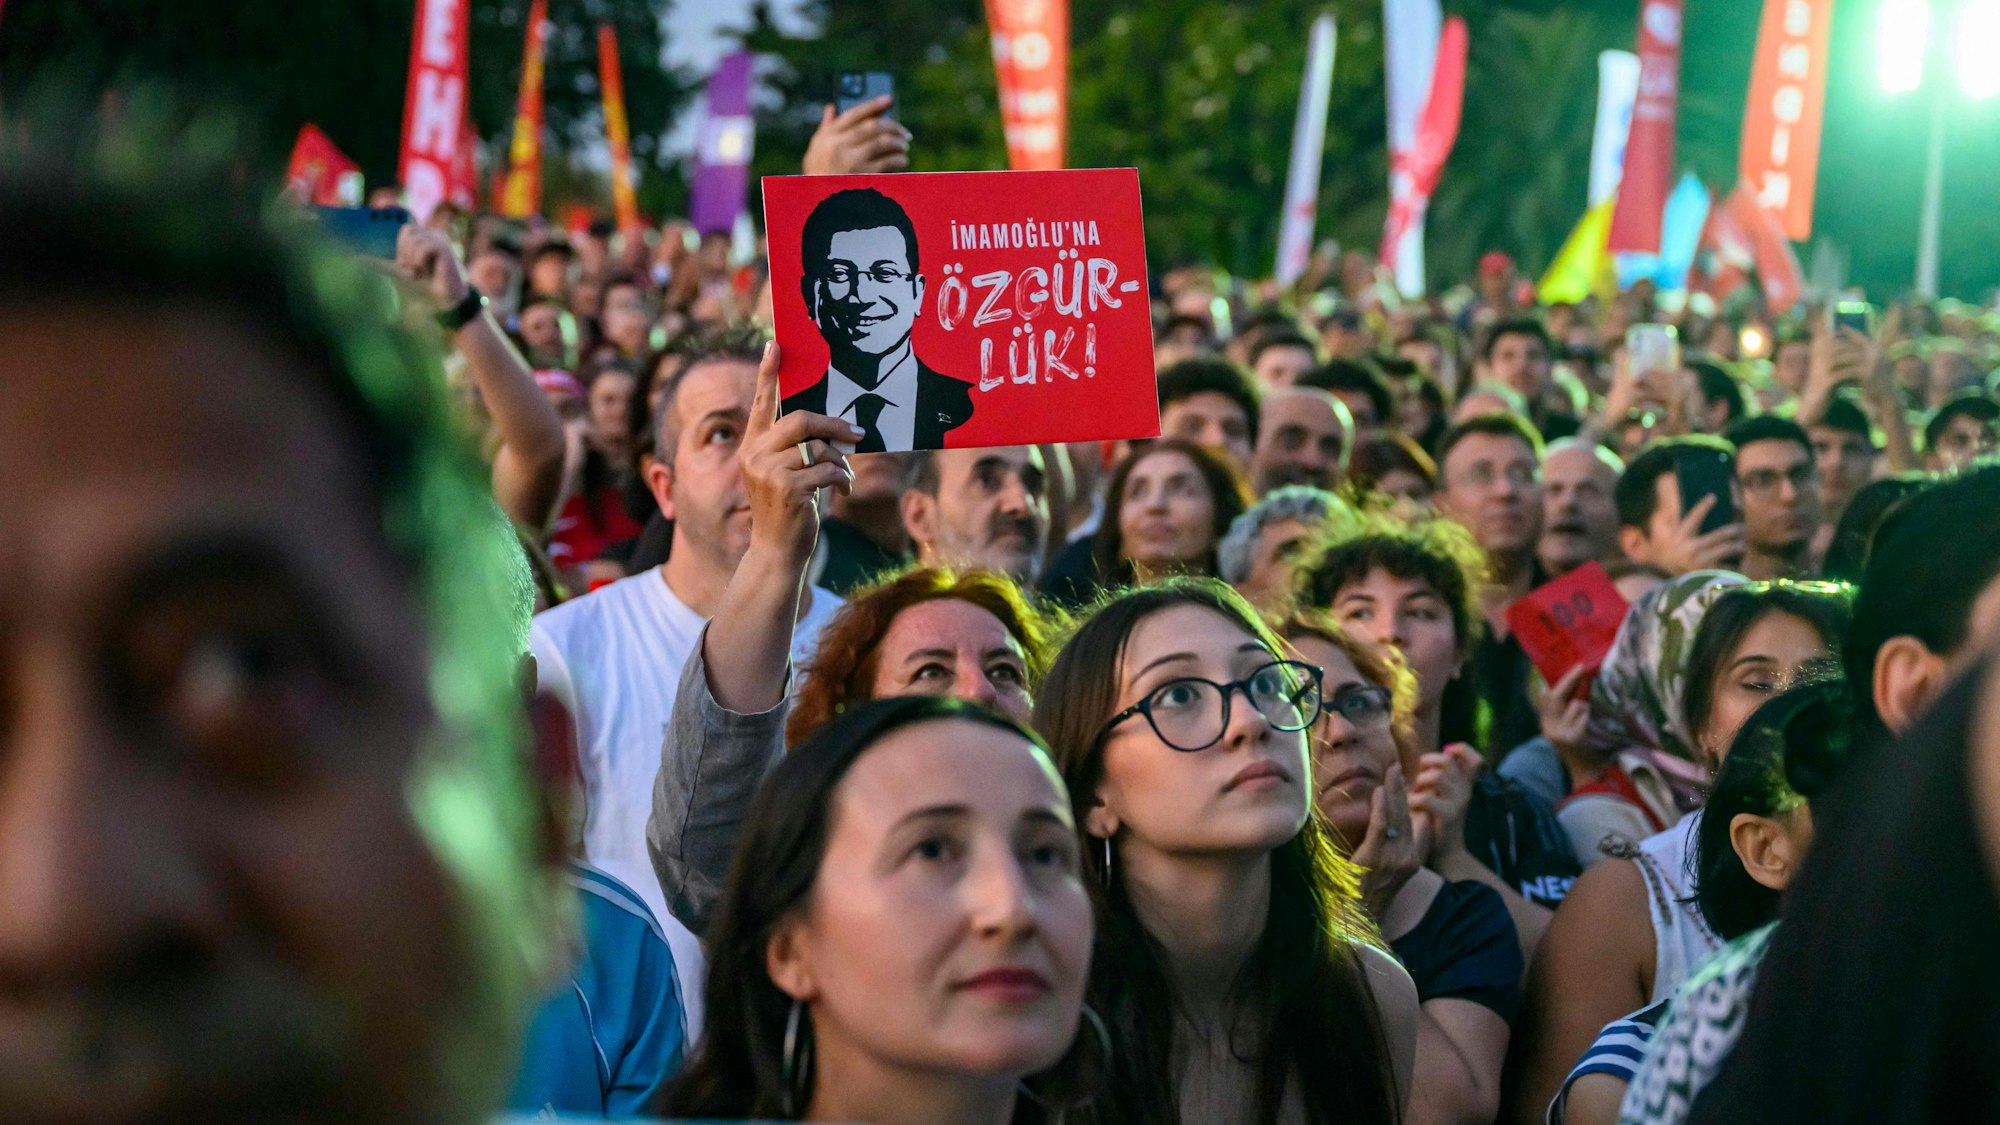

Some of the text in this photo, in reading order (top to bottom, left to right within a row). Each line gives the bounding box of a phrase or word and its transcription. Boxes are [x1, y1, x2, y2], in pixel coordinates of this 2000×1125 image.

[951, 217, 1100, 250] İMAMOĞLU'NA
[937, 248, 1140, 331] ÖZGÜR-
[979, 322, 1097, 392] LÜK!
